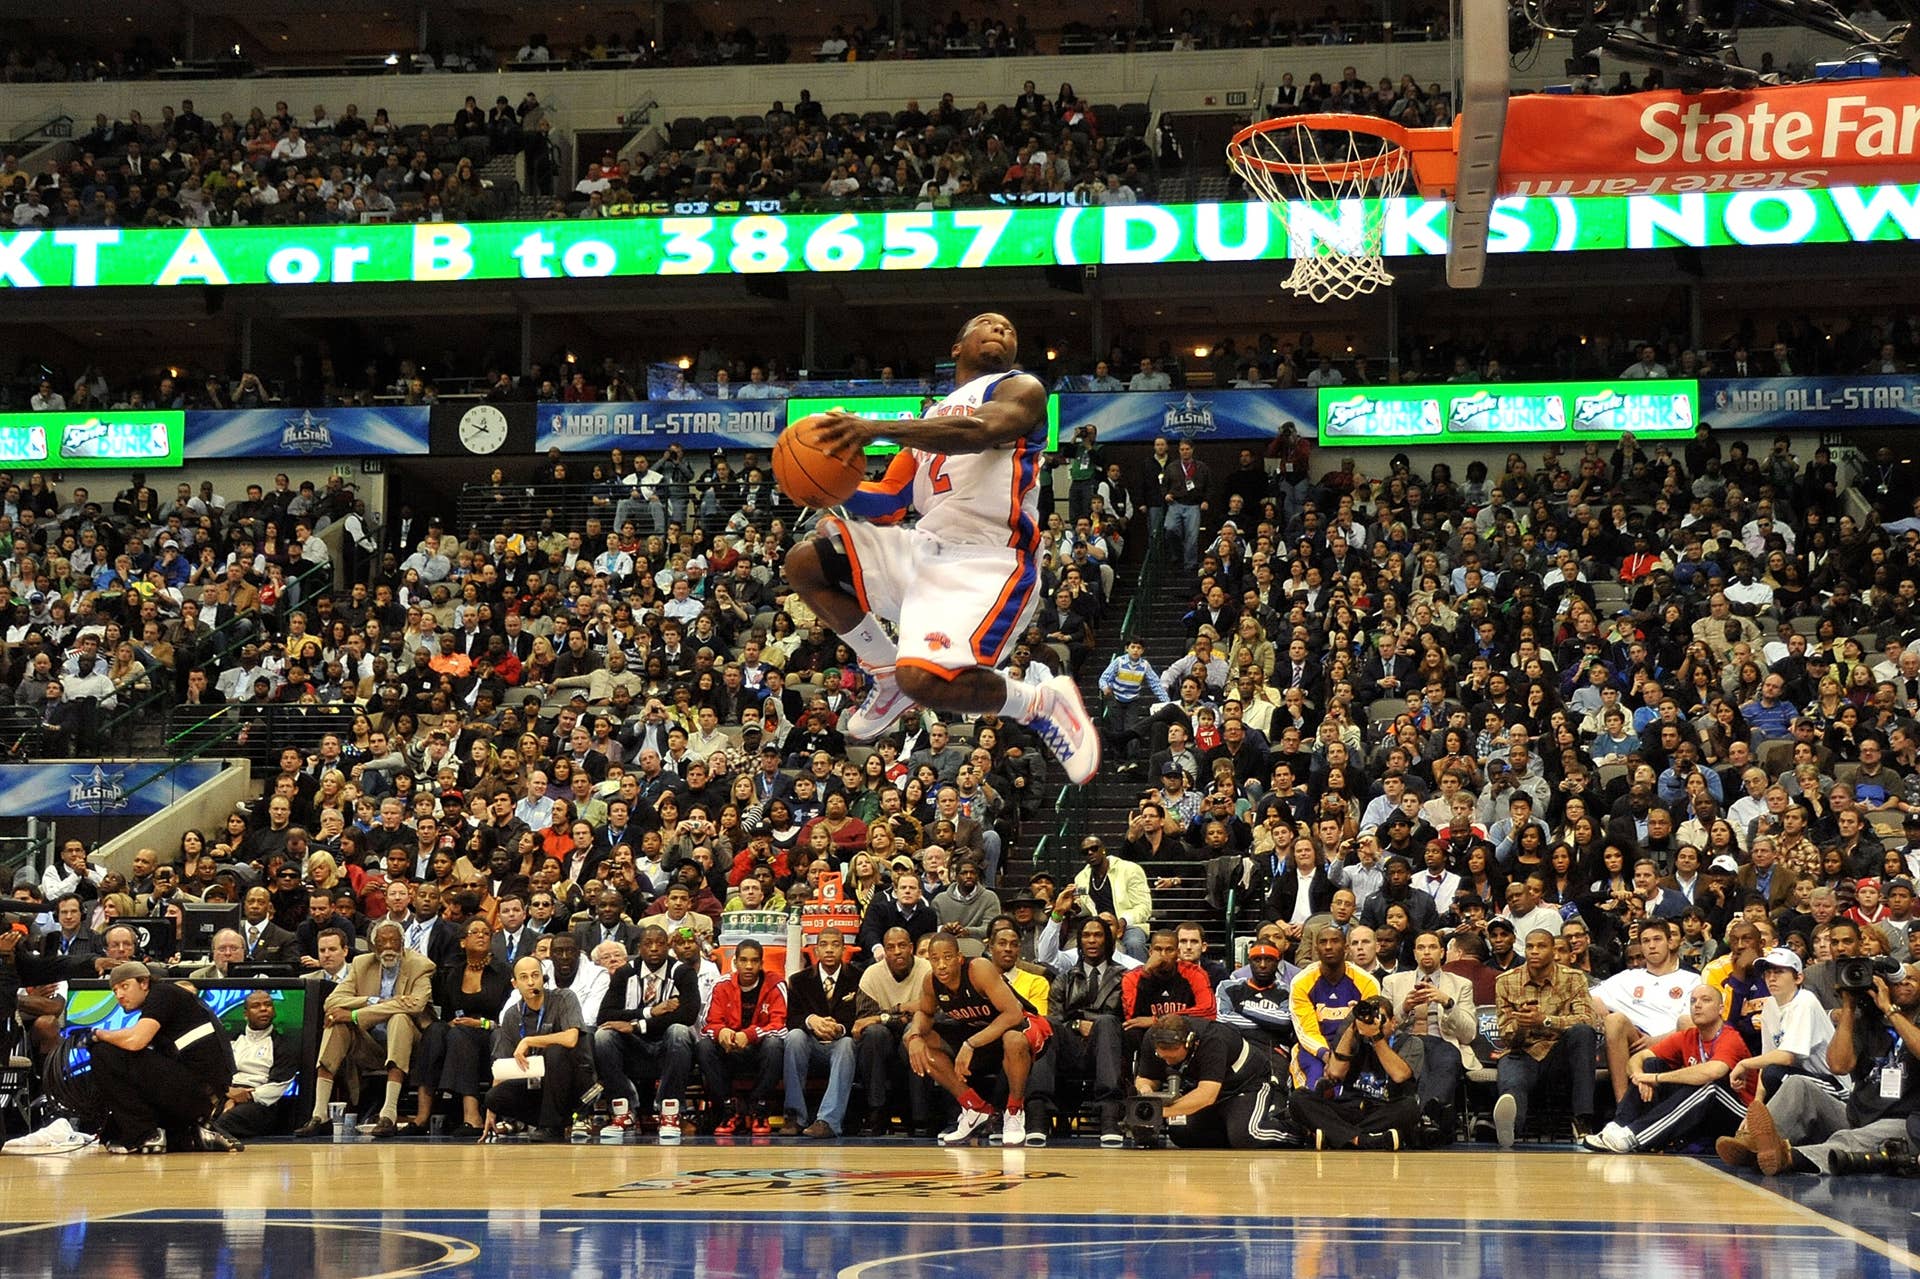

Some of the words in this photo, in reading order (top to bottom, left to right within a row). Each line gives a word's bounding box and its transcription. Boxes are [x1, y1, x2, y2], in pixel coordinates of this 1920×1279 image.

[1635, 102, 1813, 164] State
[1672, 169, 1829, 192] State
[153, 227, 230, 285] A
[267, 247, 370, 284] or
[413, 222, 474, 281] B
[513, 233, 617, 278] to
[656, 209, 1013, 274] 38657
[1731, 391, 1778, 412] NBA
[1785, 387, 1906, 411] ALL-STAR
[566, 414, 607, 435] NBA
[613, 412, 721, 433] ALL-STAR
[726, 411, 775, 432] 2010
